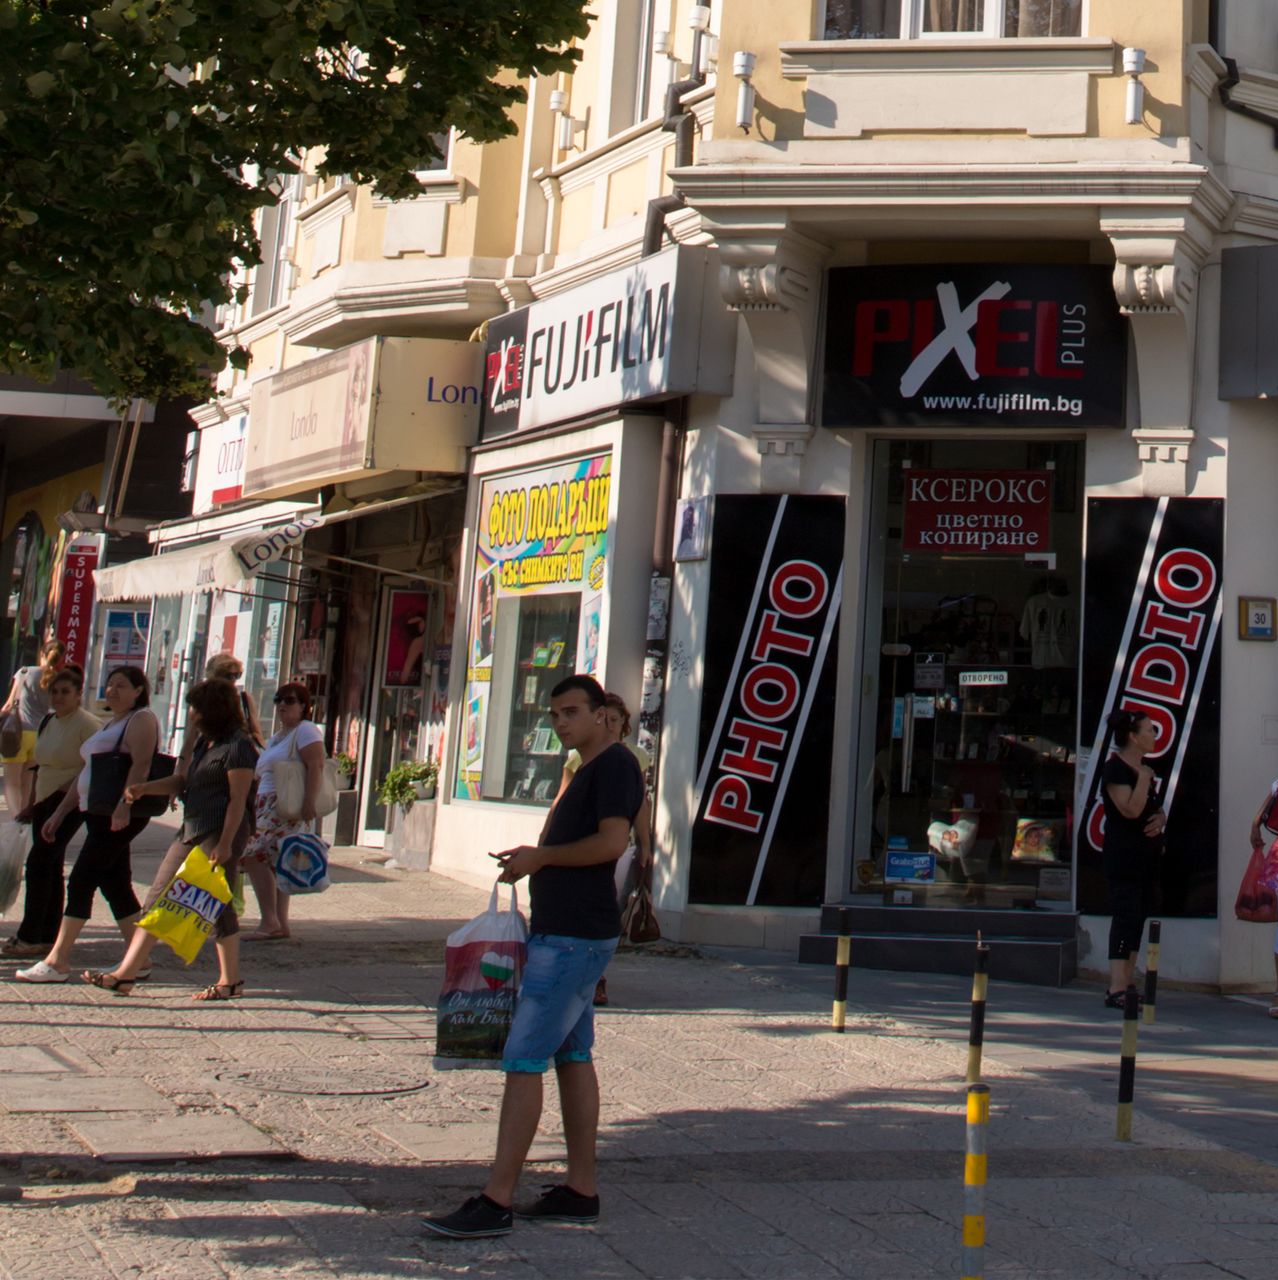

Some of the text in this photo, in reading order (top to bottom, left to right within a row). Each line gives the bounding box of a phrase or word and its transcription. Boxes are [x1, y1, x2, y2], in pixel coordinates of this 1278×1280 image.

[526, 282, 670, 399] FUJIFILM
[853, 281, 1085, 398] PIXEL
[1061, 303, 1087, 364] PLUS
[487, 336, 522, 408] PIXEL
[427, 377, 485, 404] Lon
[922, 393, 1083, 416] www.fujifilm.bg
[909, 478, 1046, 504] КСЕРОКС
[488, 473, 611, 551] ФОТО ПОДАРЪЦИ
[936, 513, 1023, 531] цветно
[919, 530, 1039, 551] копиране
[1254, 613, 1266, 625] 30
[962, 673, 1005, 682] ОТВОРЕНО
[703, 559, 830, 834] PHOTO
[158, 899, 190, 919] DUTY
